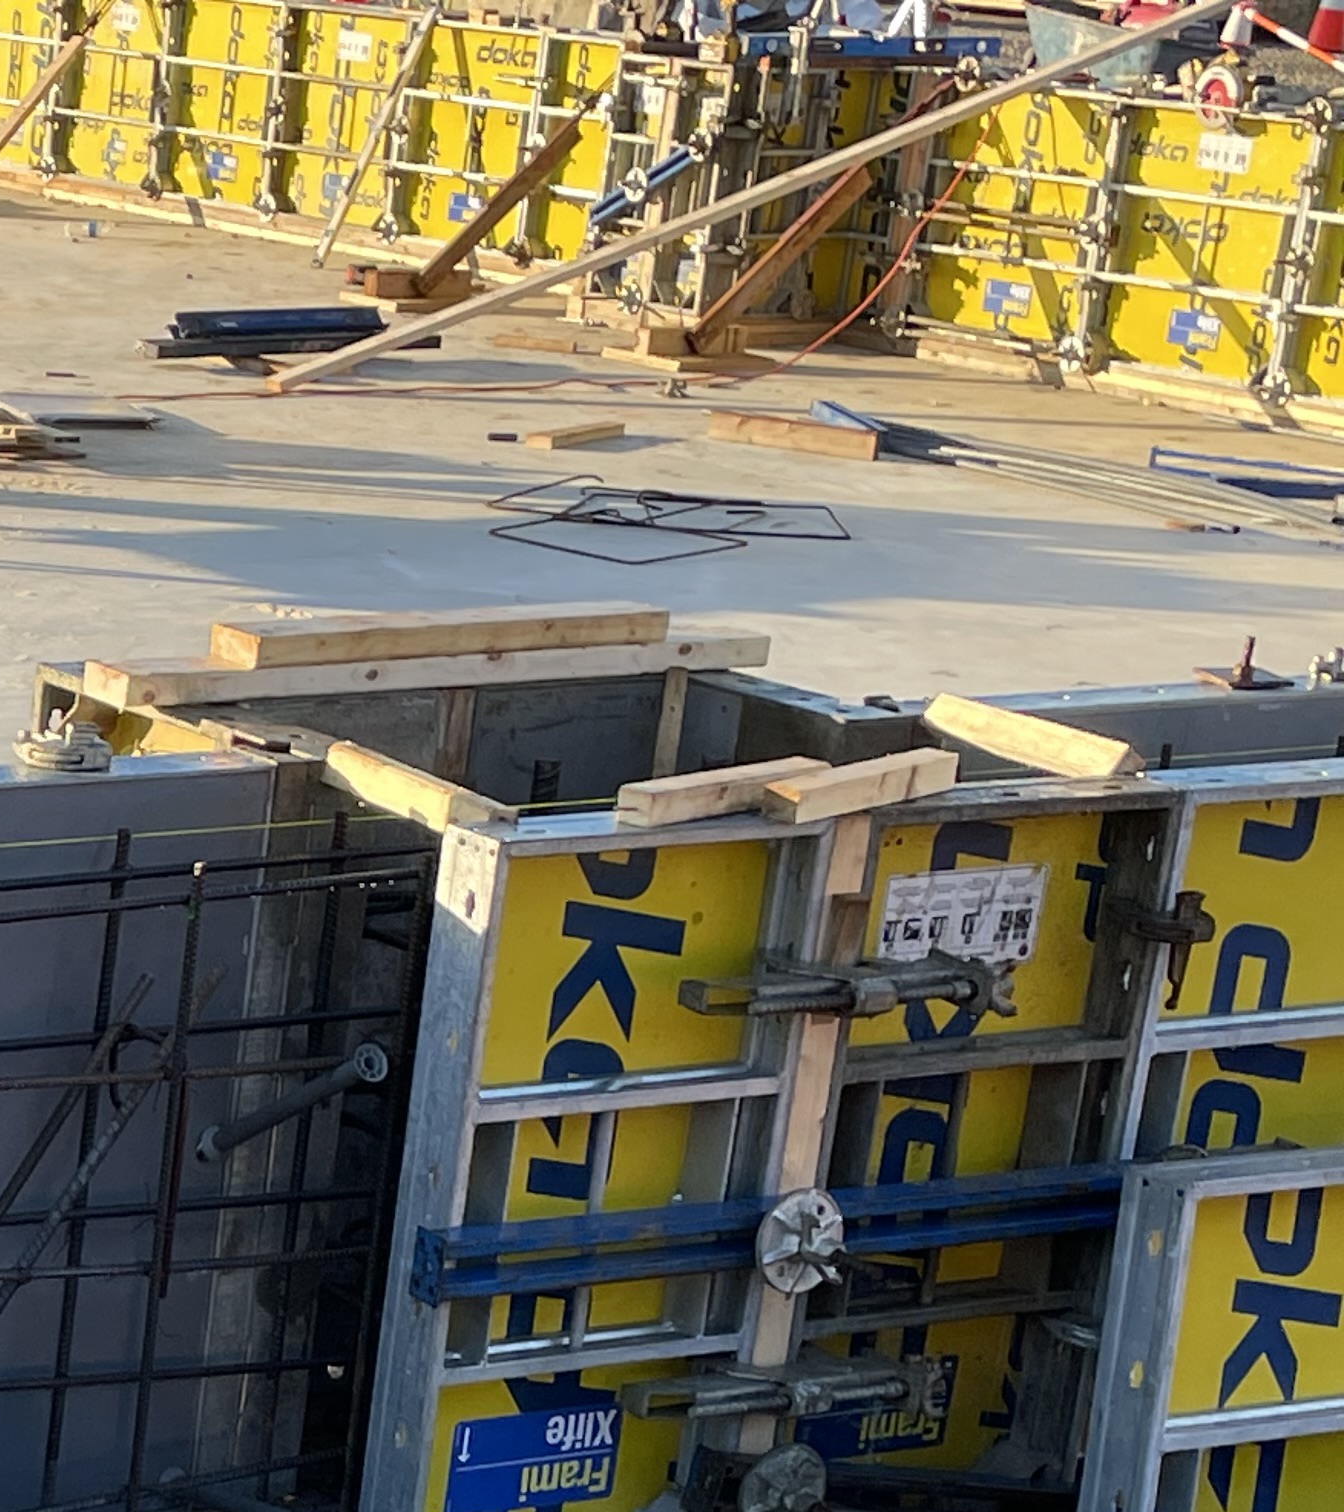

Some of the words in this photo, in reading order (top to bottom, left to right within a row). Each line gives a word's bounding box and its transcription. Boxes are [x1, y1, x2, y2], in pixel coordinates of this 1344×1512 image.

[476, 38, 537, 69] doka
[1140, 210, 1230, 248] doka
[545, 1408, 617, 1447] Xlife
[518, 1454, 611, 1502] Frami
